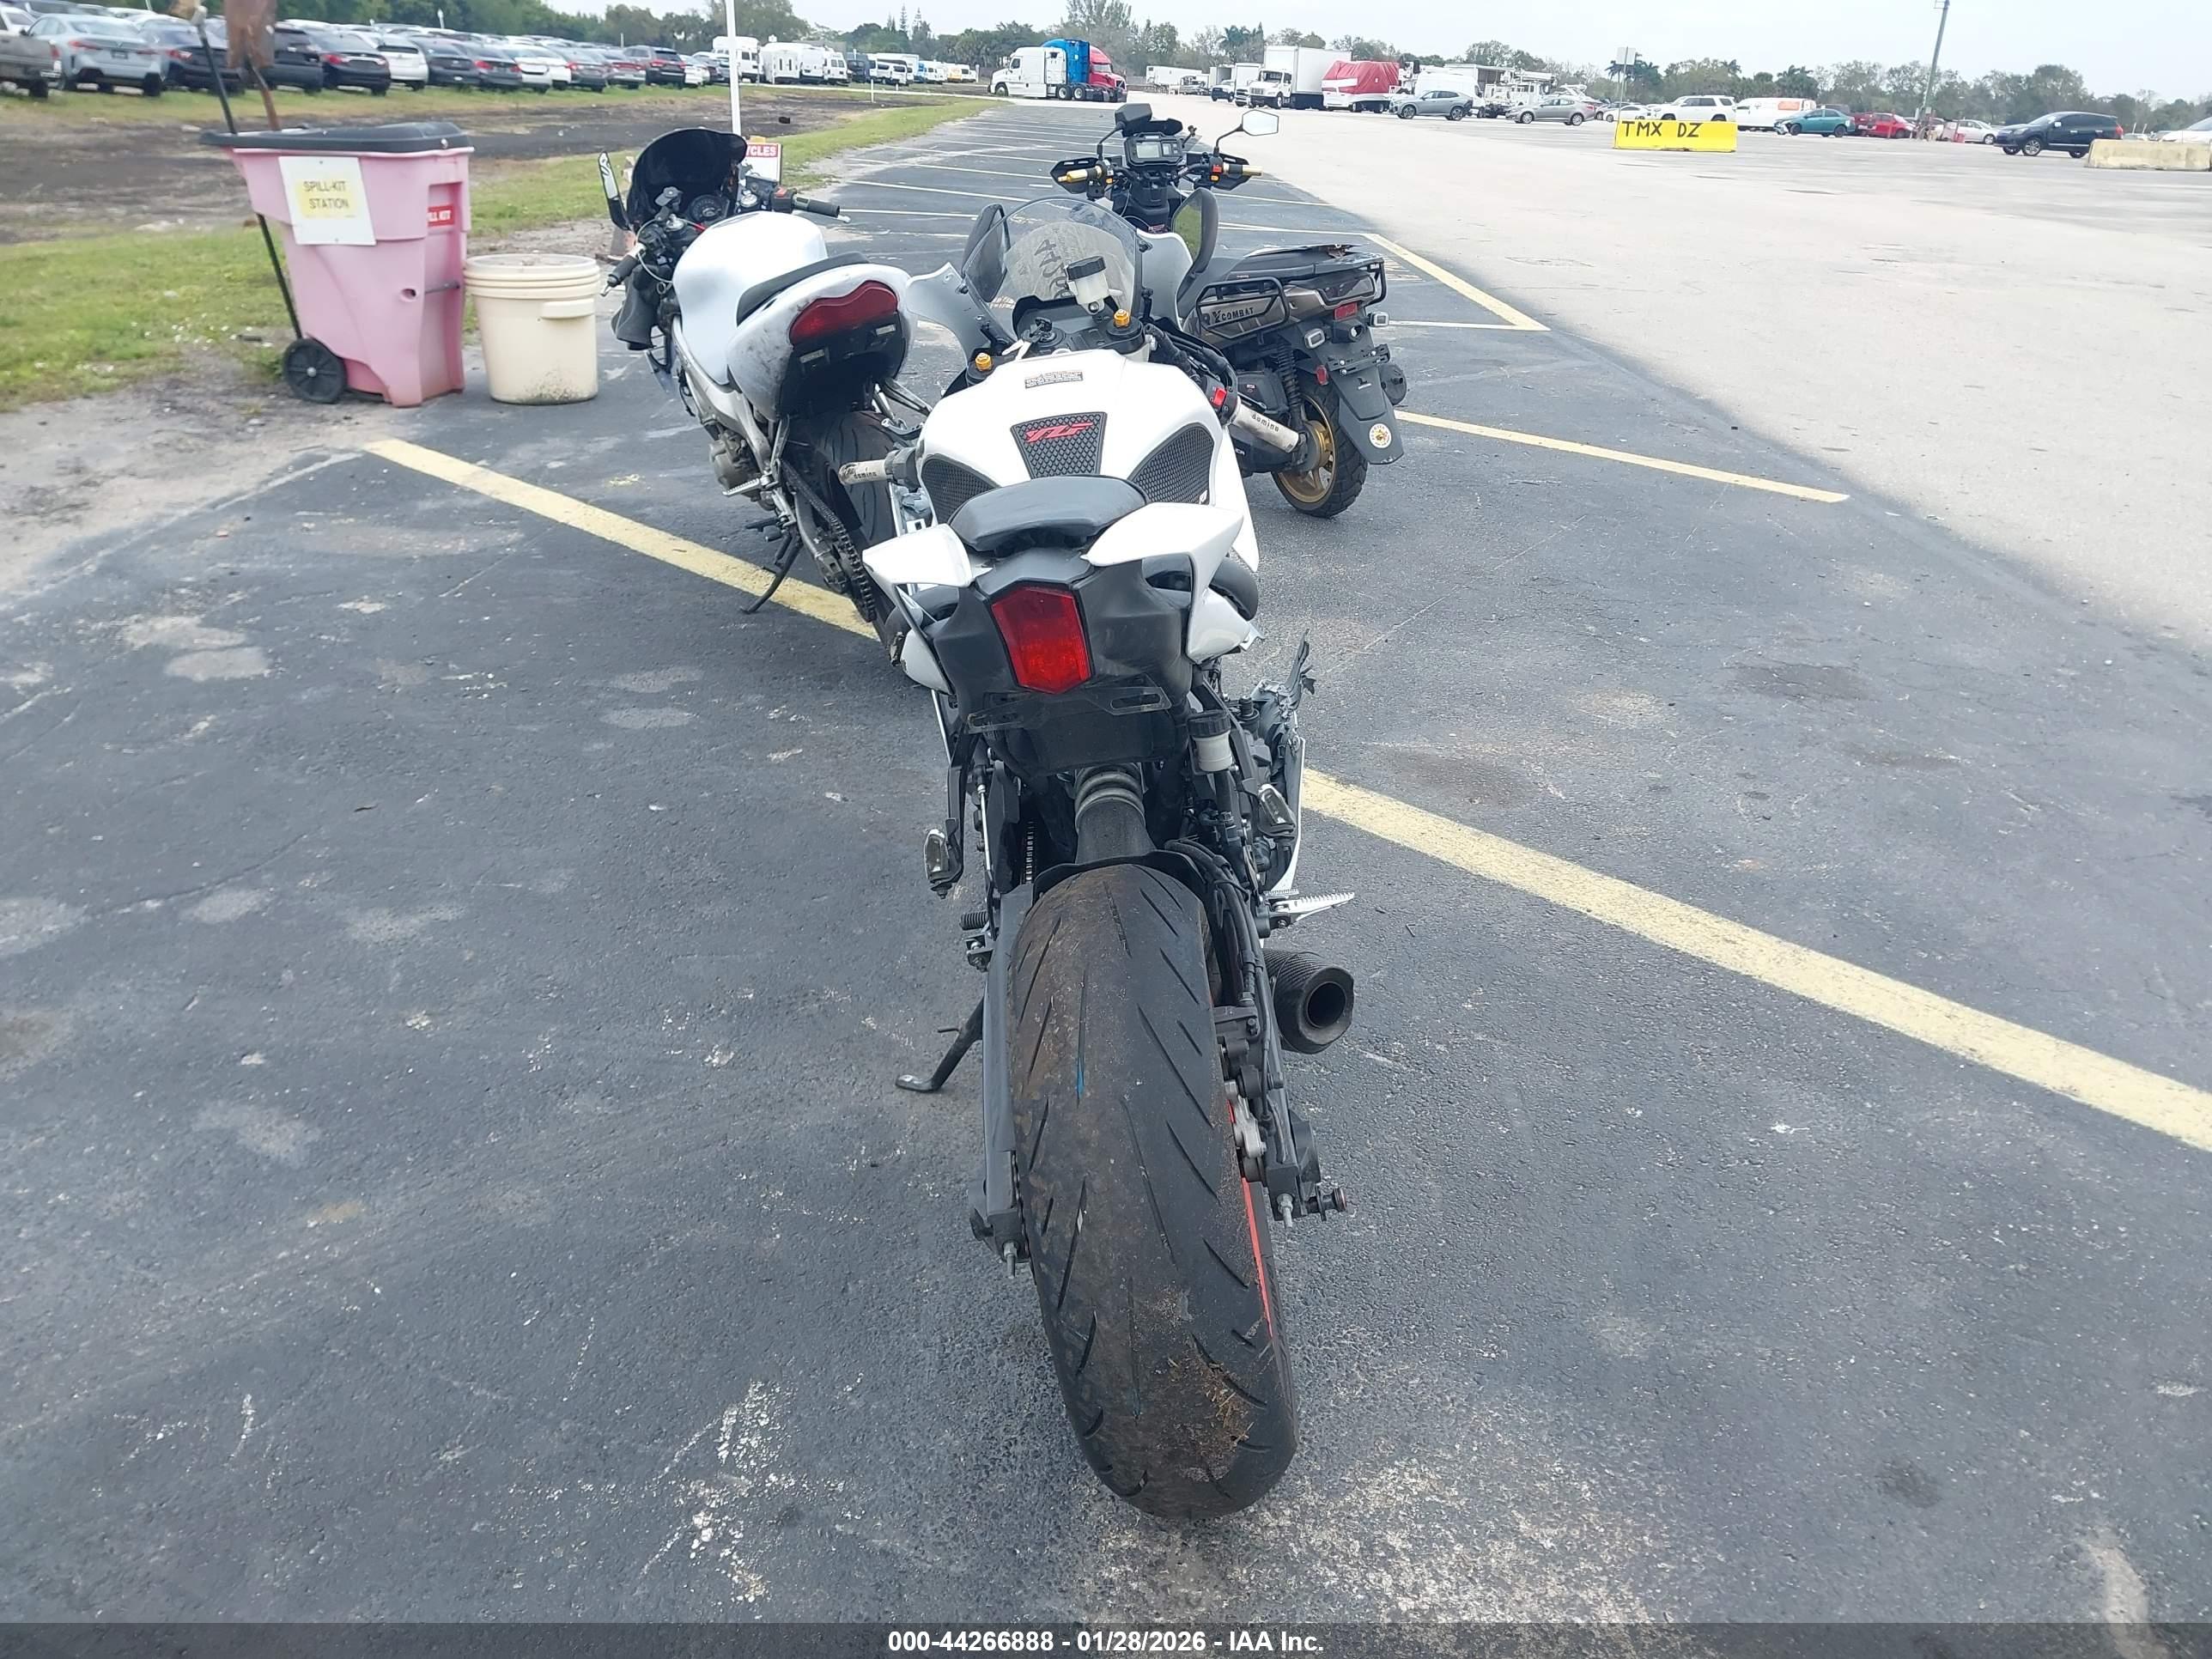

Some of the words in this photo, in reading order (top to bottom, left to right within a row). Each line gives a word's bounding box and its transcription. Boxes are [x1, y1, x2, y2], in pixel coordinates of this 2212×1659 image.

[1621, 120, 1662, 137] TMX
[1677, 122, 1704, 137] DZ
[308, 198, 349, 210] STATION
[1251, 412, 1279, 432] domino
